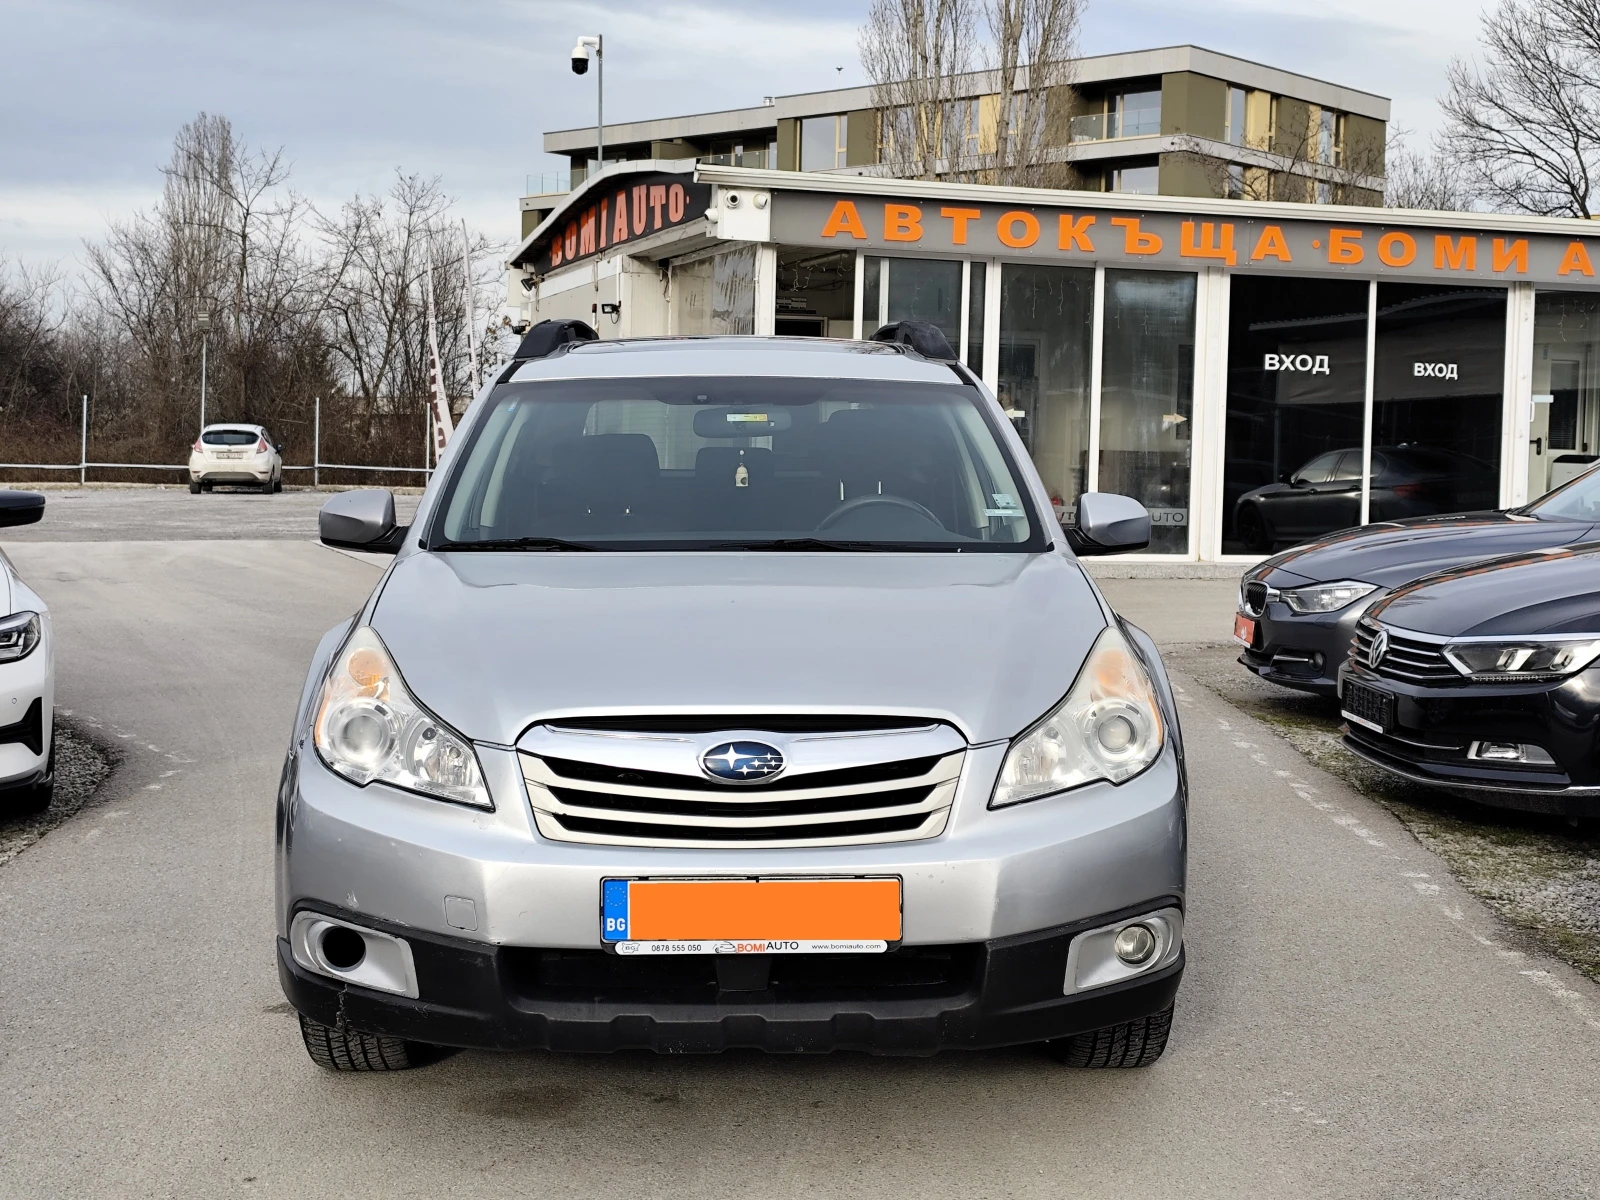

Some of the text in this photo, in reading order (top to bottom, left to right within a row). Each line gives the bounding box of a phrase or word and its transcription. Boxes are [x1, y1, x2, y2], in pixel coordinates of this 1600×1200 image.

[820, 200, 1596, 277] АВТОКЪЩА БОМИ А
[1263, 353, 1331, 375] ВХОД
[1413, 362, 1459, 381] ВХОД
[1151, 512, 1184, 523] UTO
[606, 917, 626, 932] BG
[651, 944, 702, 952] 0878 555 050
